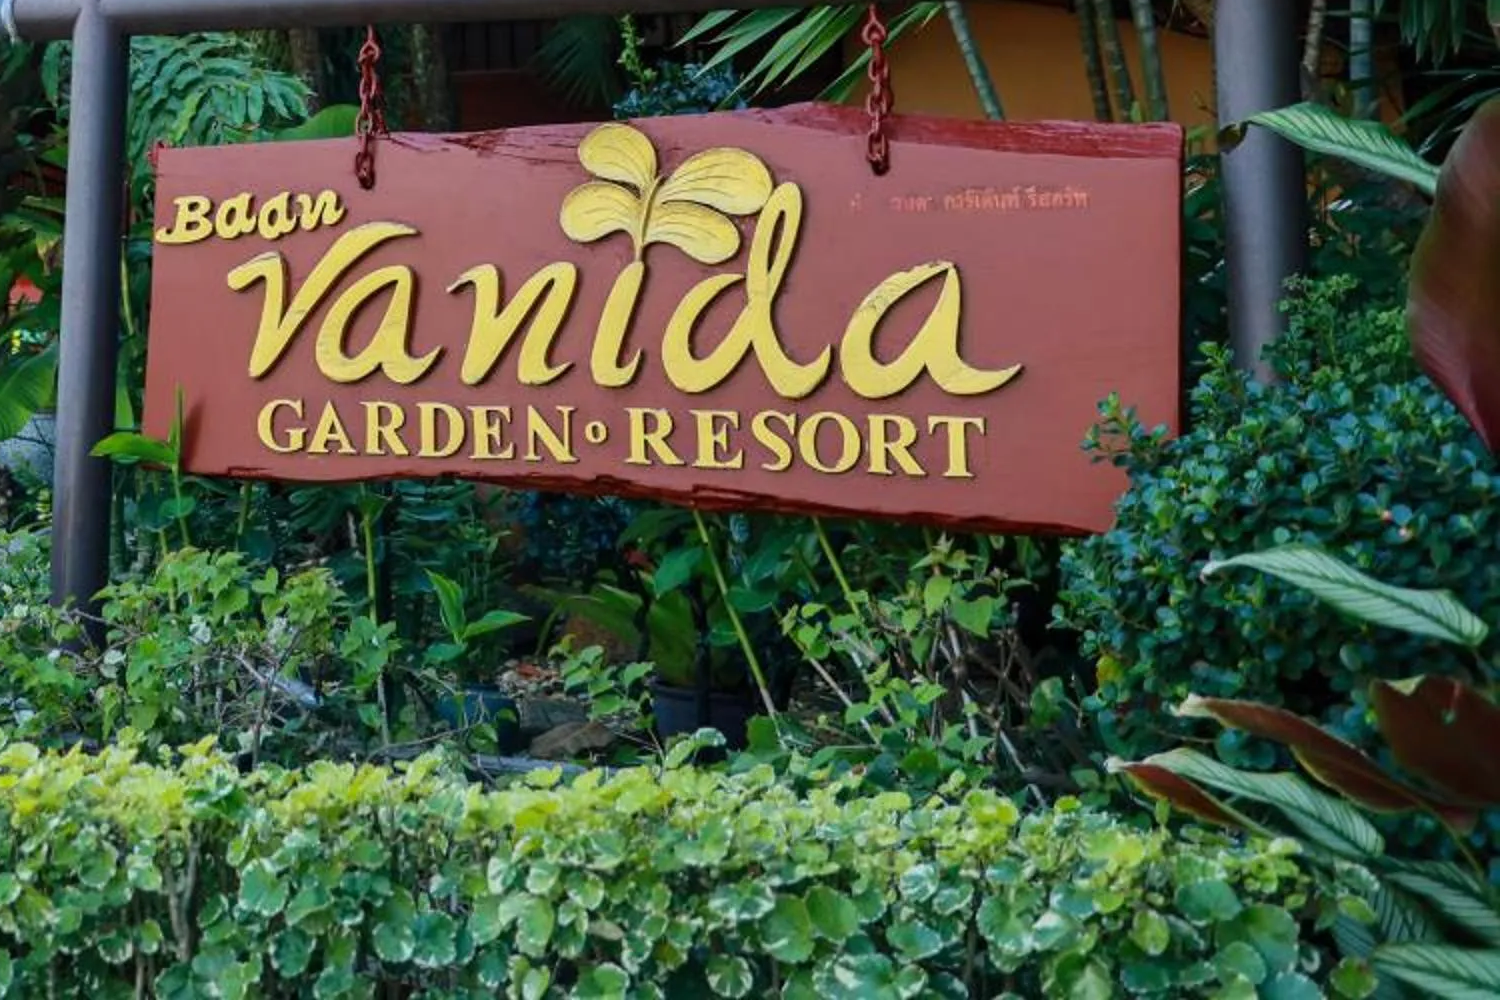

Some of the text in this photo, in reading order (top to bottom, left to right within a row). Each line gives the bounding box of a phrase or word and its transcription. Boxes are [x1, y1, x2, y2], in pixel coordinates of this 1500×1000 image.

[154, 188, 347, 245] Baan
[227, 181, 1024, 400] Vanida
[257, 398, 987, 480] GARDEN RESORT
